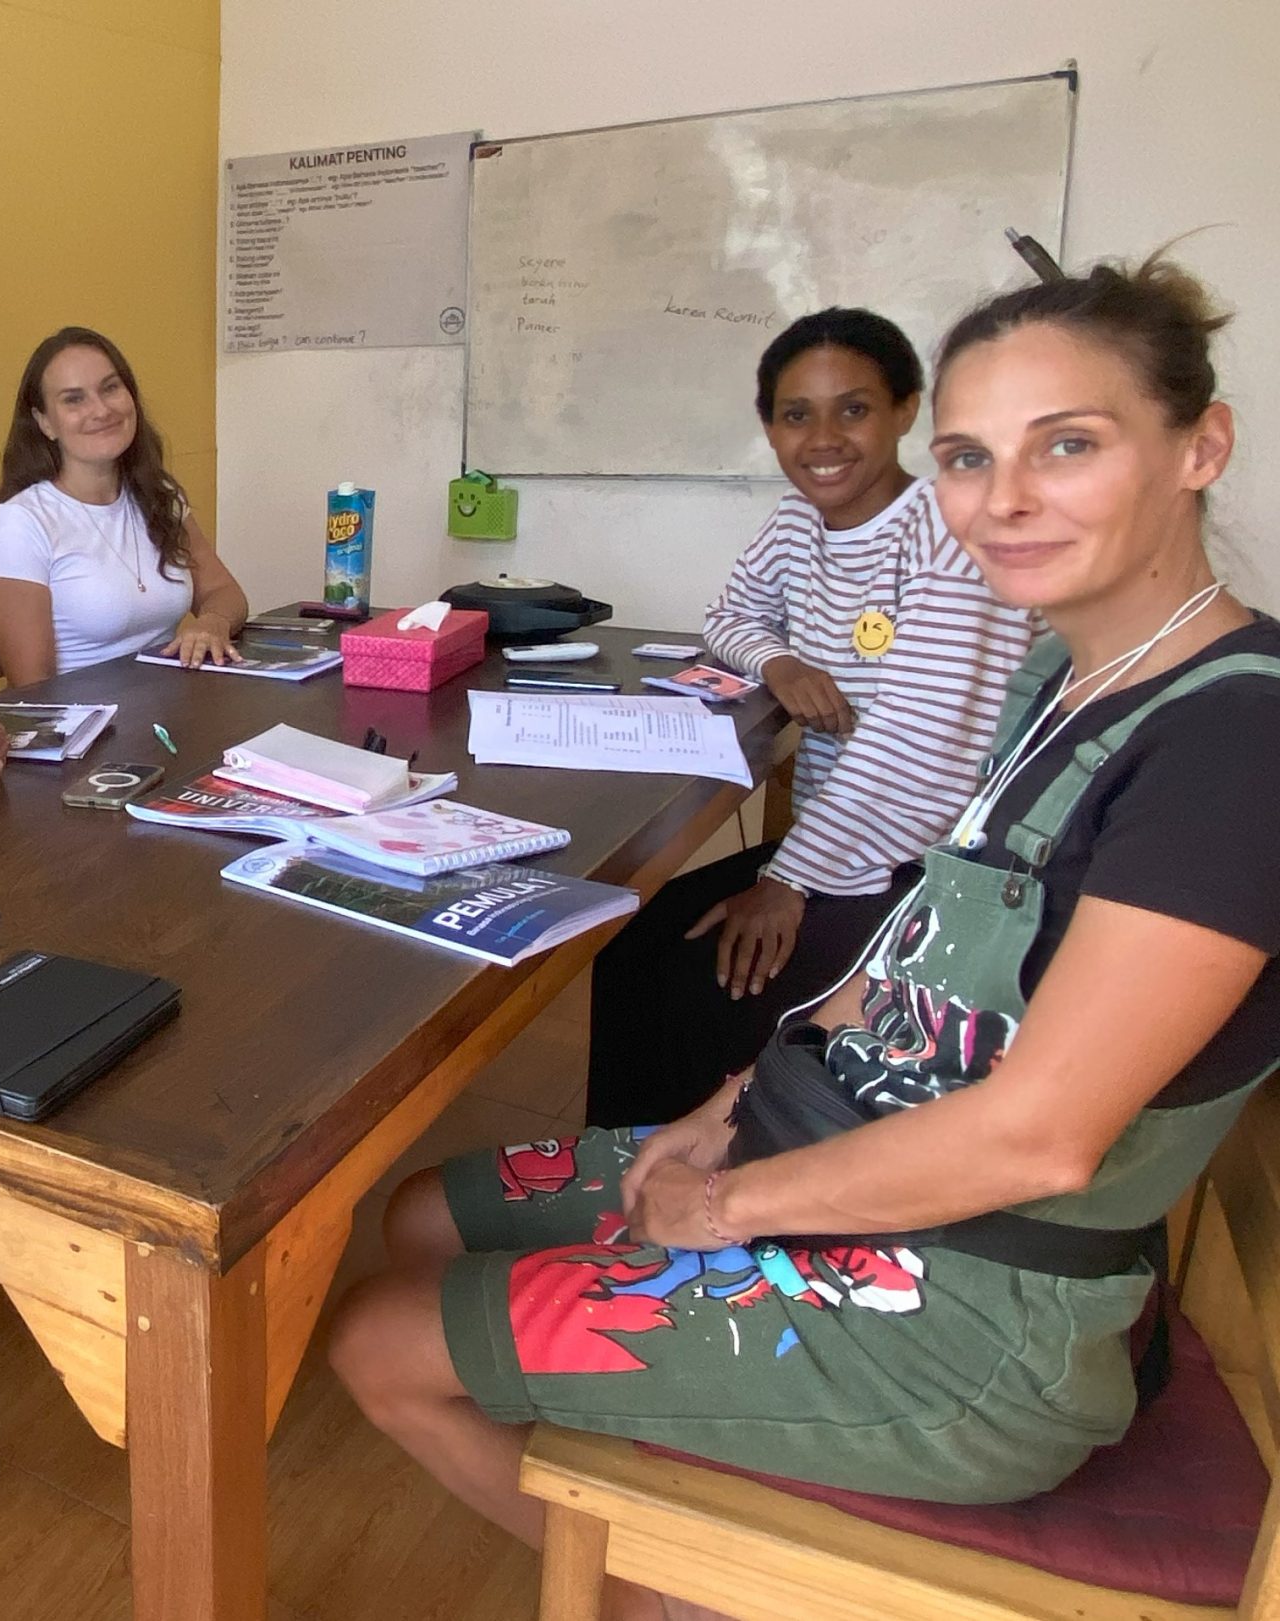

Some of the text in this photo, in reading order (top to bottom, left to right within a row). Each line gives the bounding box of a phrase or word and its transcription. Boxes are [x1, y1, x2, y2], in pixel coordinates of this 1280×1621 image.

[289, 145, 407, 170] KALIMAT PENTING
[432, 881, 546, 931] PEMULA
